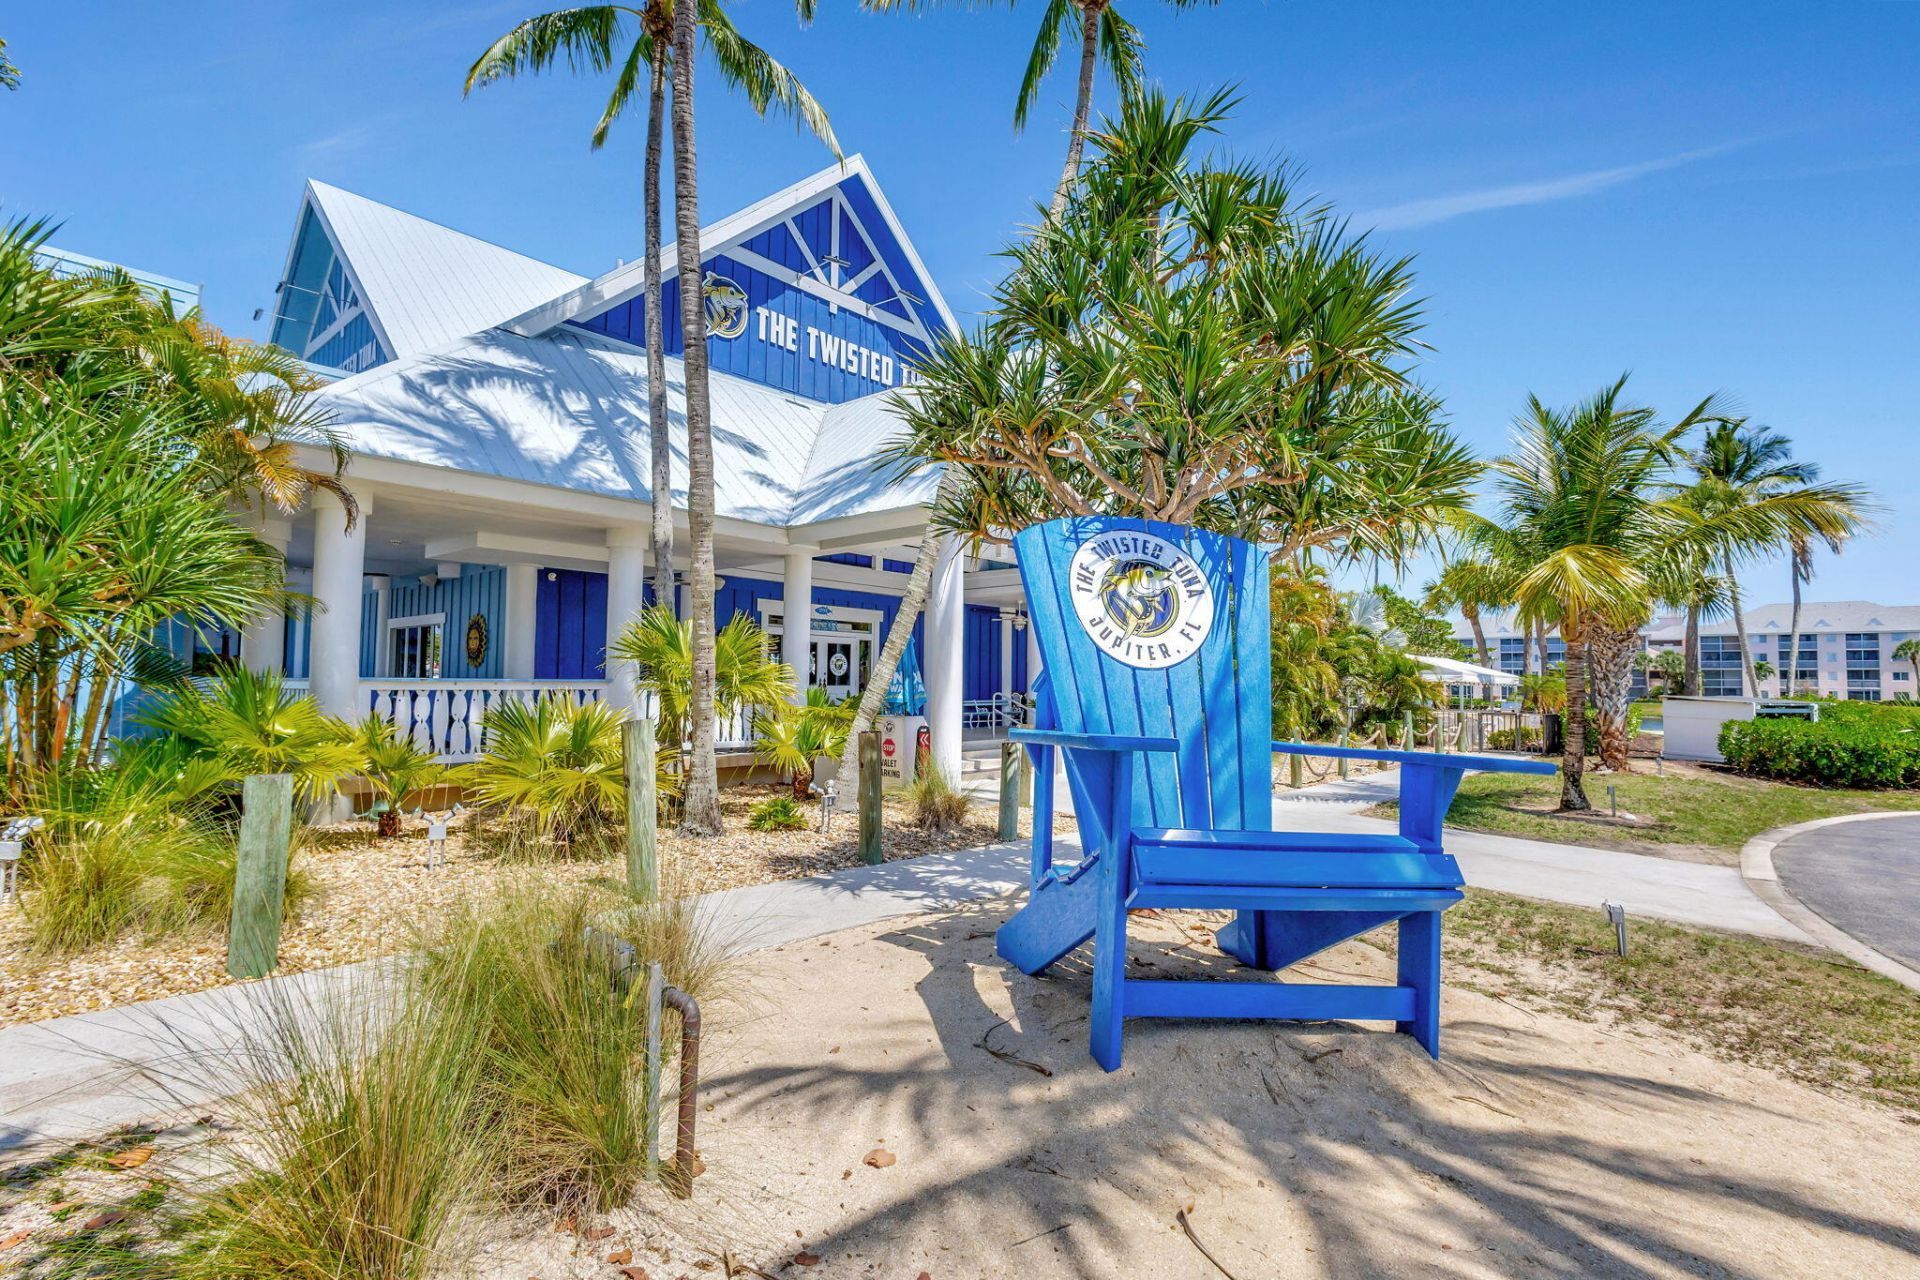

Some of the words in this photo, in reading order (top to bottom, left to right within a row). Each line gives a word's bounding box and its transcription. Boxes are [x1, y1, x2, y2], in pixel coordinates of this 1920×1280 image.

[756, 306, 799, 352] THE
[807, 326, 894, 387] TWISTED
[1076, 563, 1096, 593] THE
[1091, 537, 1163, 560] TWISTED
[1169, 556, 1205, 599] TUNA
[1180, 622, 1202, 642] FL
[880, 769, 901, 779] ARKING
